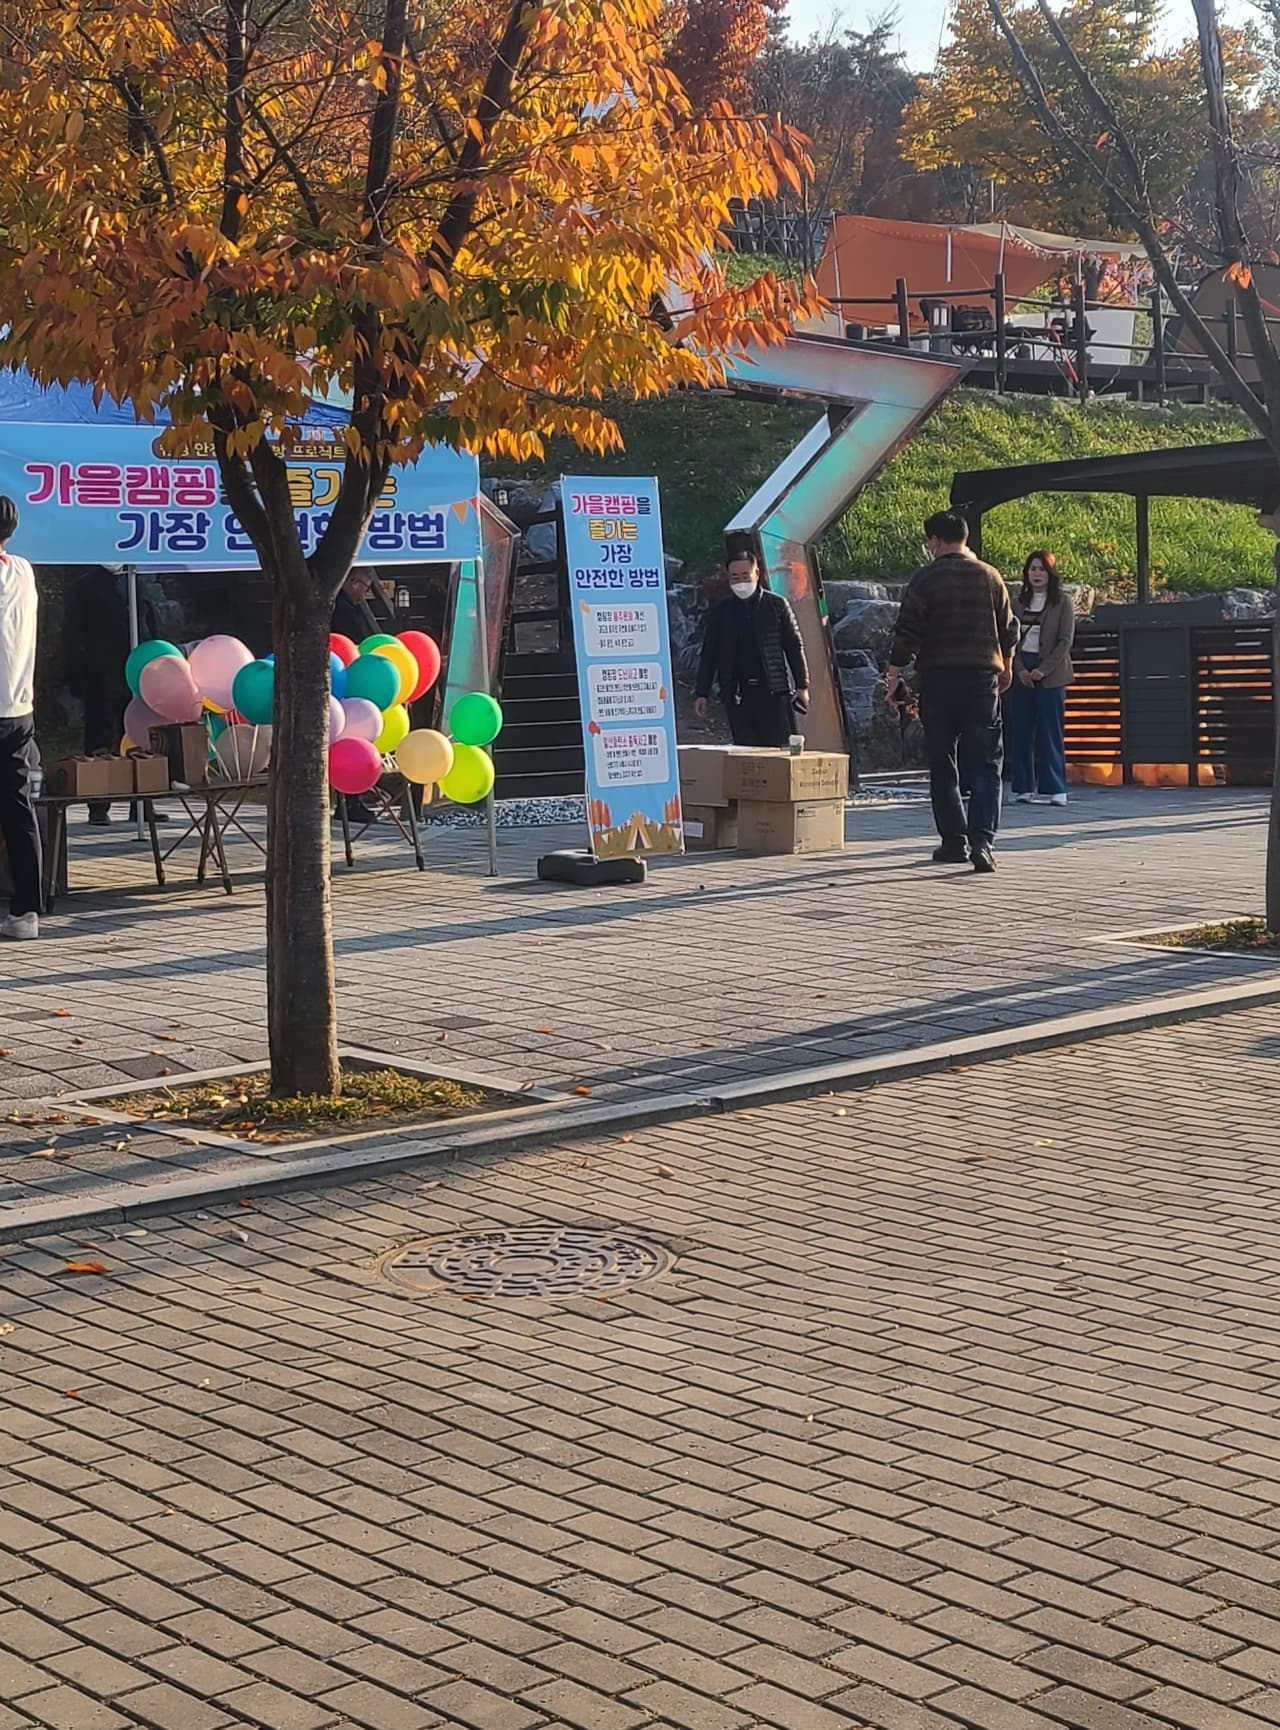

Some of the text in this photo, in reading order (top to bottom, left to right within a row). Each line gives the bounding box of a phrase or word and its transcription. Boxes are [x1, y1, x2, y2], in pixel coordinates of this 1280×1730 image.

[25, 463, 232, 507] 가을캠핑
[571, 494, 652, 515] 가을캠핑을
[117, 511, 211, 551] 가장
[367, 511, 446, 550] 방법
[588, 518, 639, 540] 즐기는
[600, 544, 632, 563] 가장
[575, 568, 660, 588] 안전한 방법
